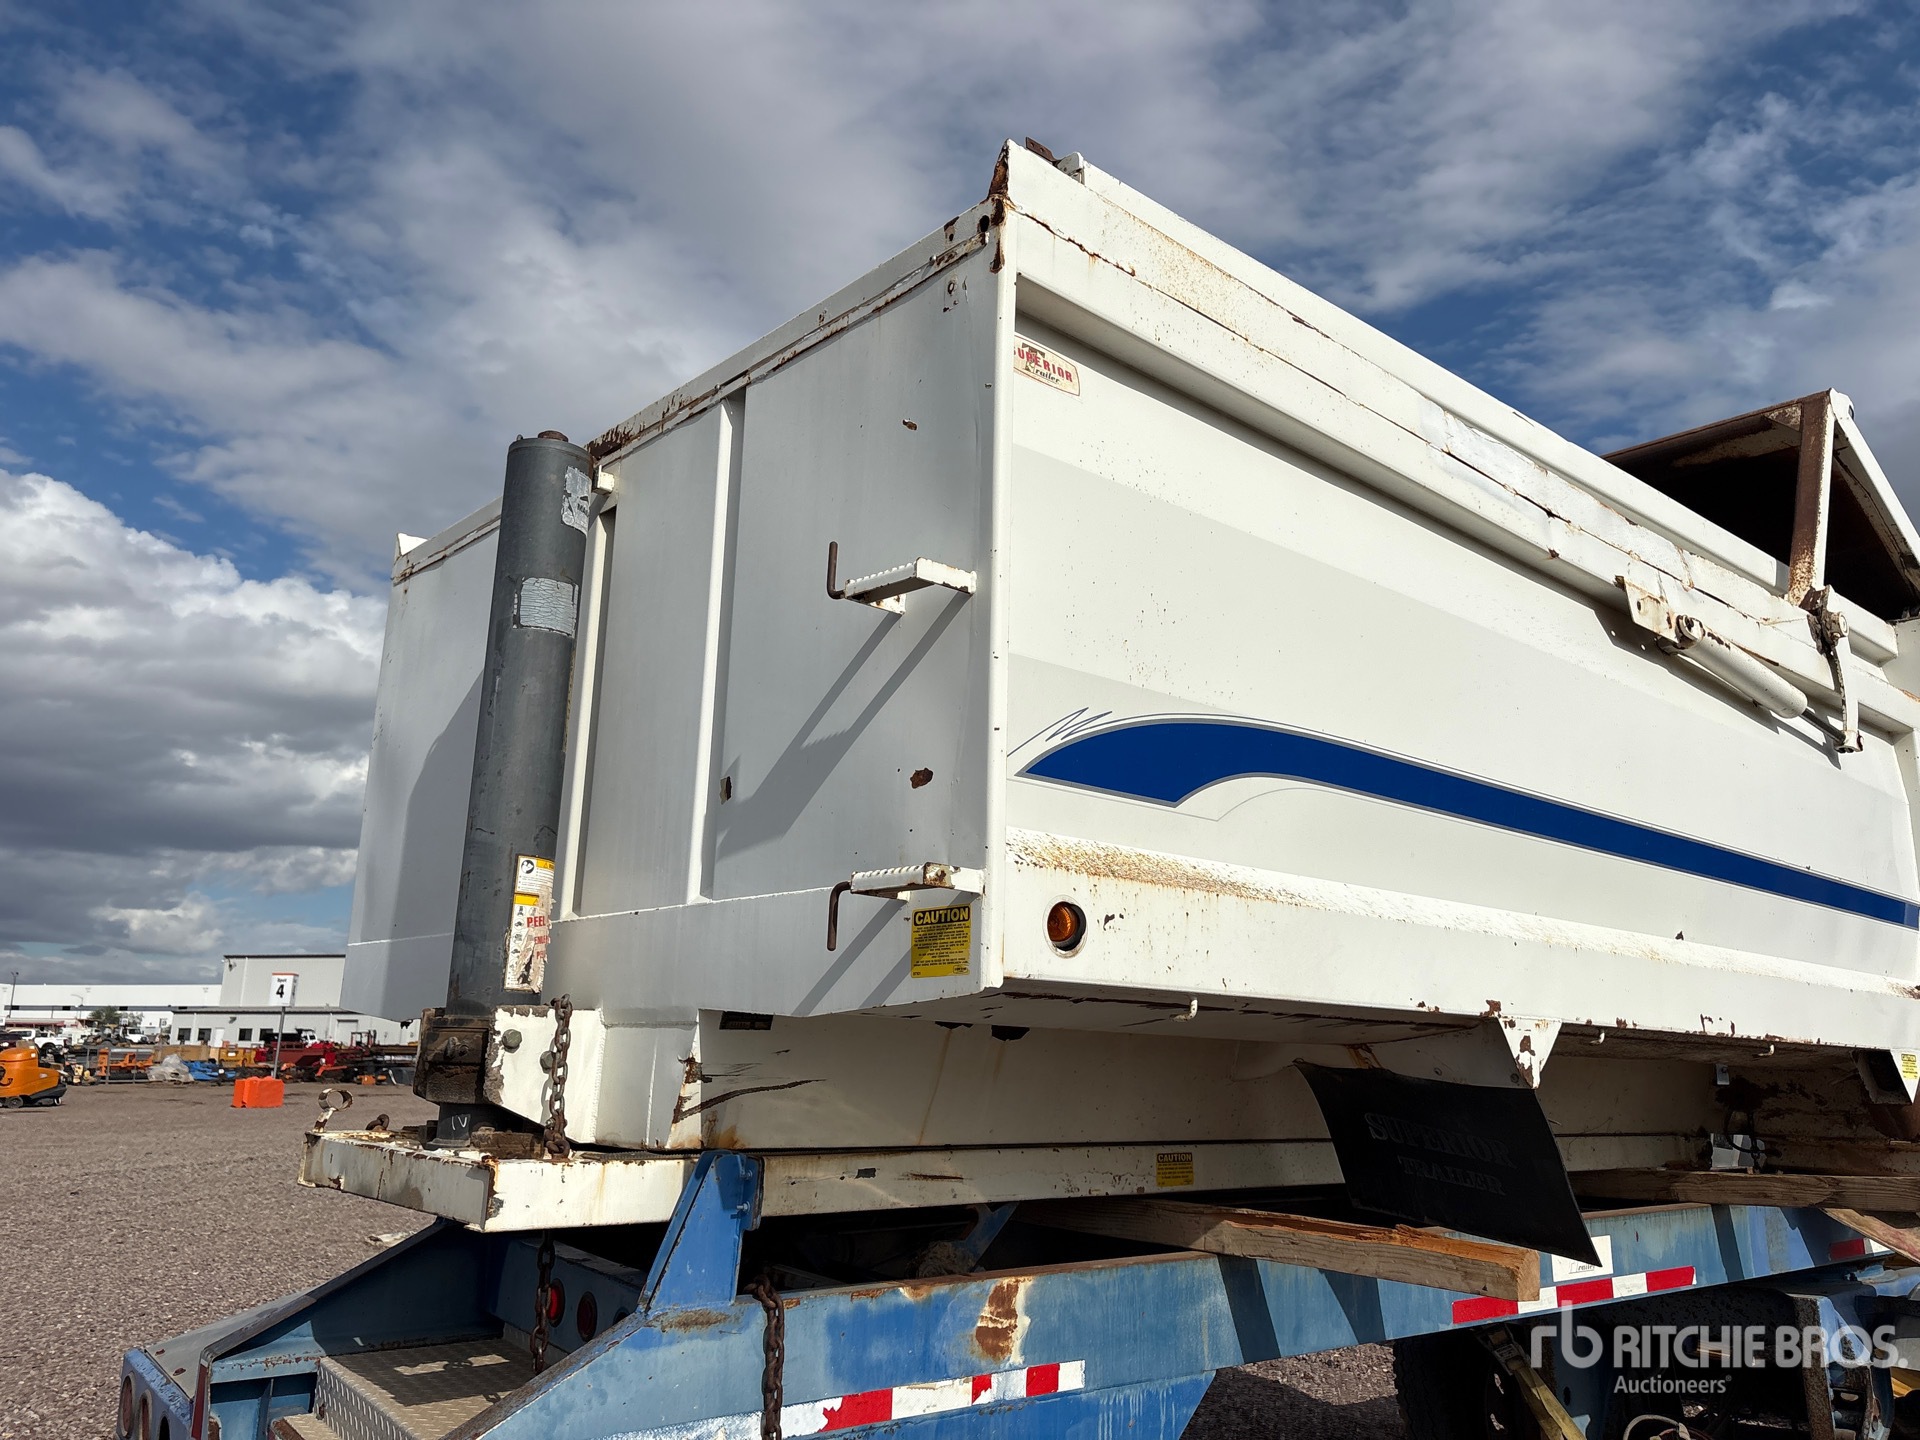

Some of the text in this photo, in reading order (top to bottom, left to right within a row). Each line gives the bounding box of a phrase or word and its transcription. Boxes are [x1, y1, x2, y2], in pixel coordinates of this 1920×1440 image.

[915, 907, 969, 925] CAUTION
[276, 984, 284, 998] 4
[1364, 1112, 1517, 1169] SUPERIOR
[1158, 1153, 1192, 1162] CAUTION
[1397, 1155, 1506, 1196] TRAILER
